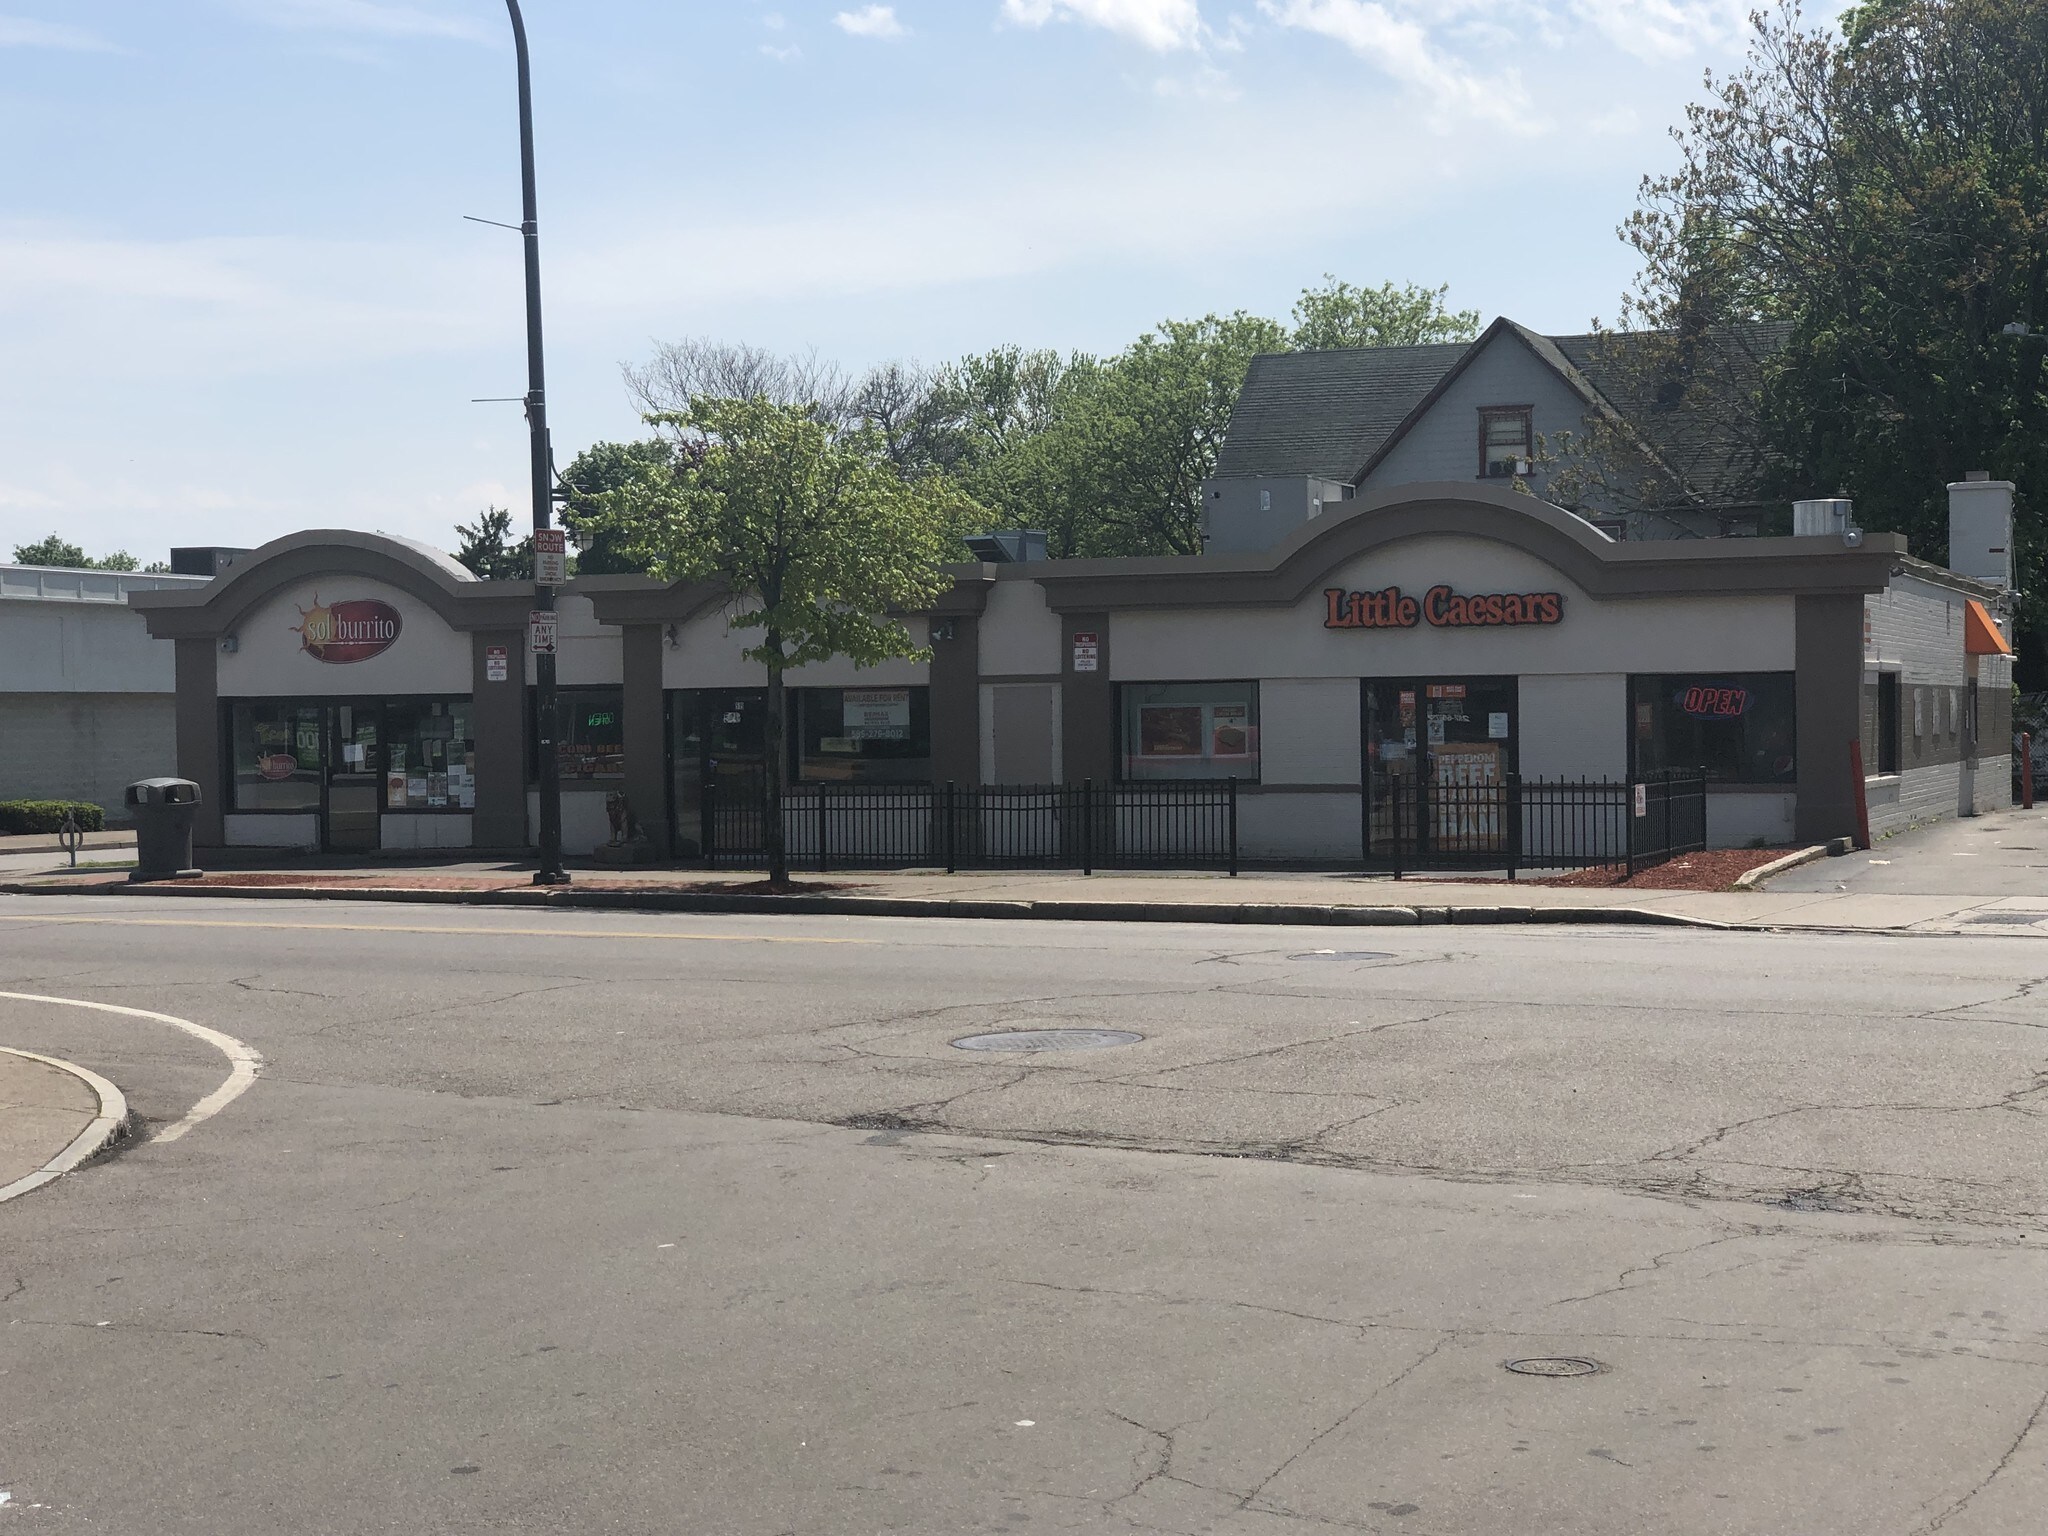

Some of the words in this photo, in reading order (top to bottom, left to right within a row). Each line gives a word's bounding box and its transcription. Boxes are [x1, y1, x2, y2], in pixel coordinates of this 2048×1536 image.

[538, 533, 562, 542] SNOW
[537, 543, 563, 552] ROUTE
[1325, 587, 1419, 628] Little
[1424, 586, 1563, 626] Caesars
[308, 613, 332, 641] sol
[338, 613, 395, 640] burrito
[535, 625, 553, 634] ANY
[534, 634, 554, 644] TIME
[1683, 687, 1746, 715] OPEN
[1439, 753, 1495, 763] PEPPERONI
